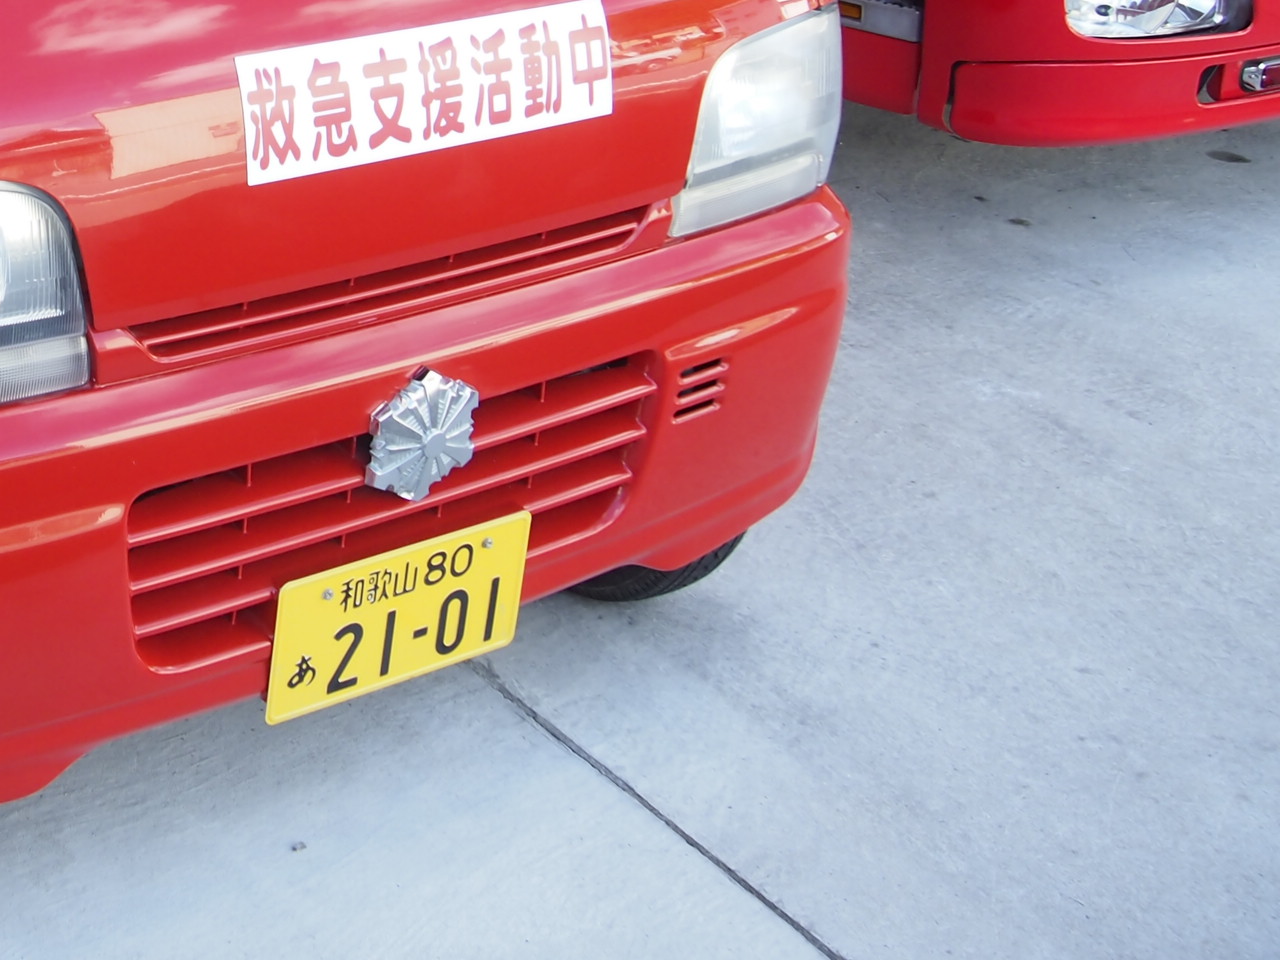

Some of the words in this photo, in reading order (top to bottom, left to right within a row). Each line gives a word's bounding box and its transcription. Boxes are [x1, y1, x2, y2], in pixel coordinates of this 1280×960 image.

[247, 13, 609, 171] 救急支援活動中
[287, 655, 316, 689] あ
[326, 576, 501, 696] 21-01
